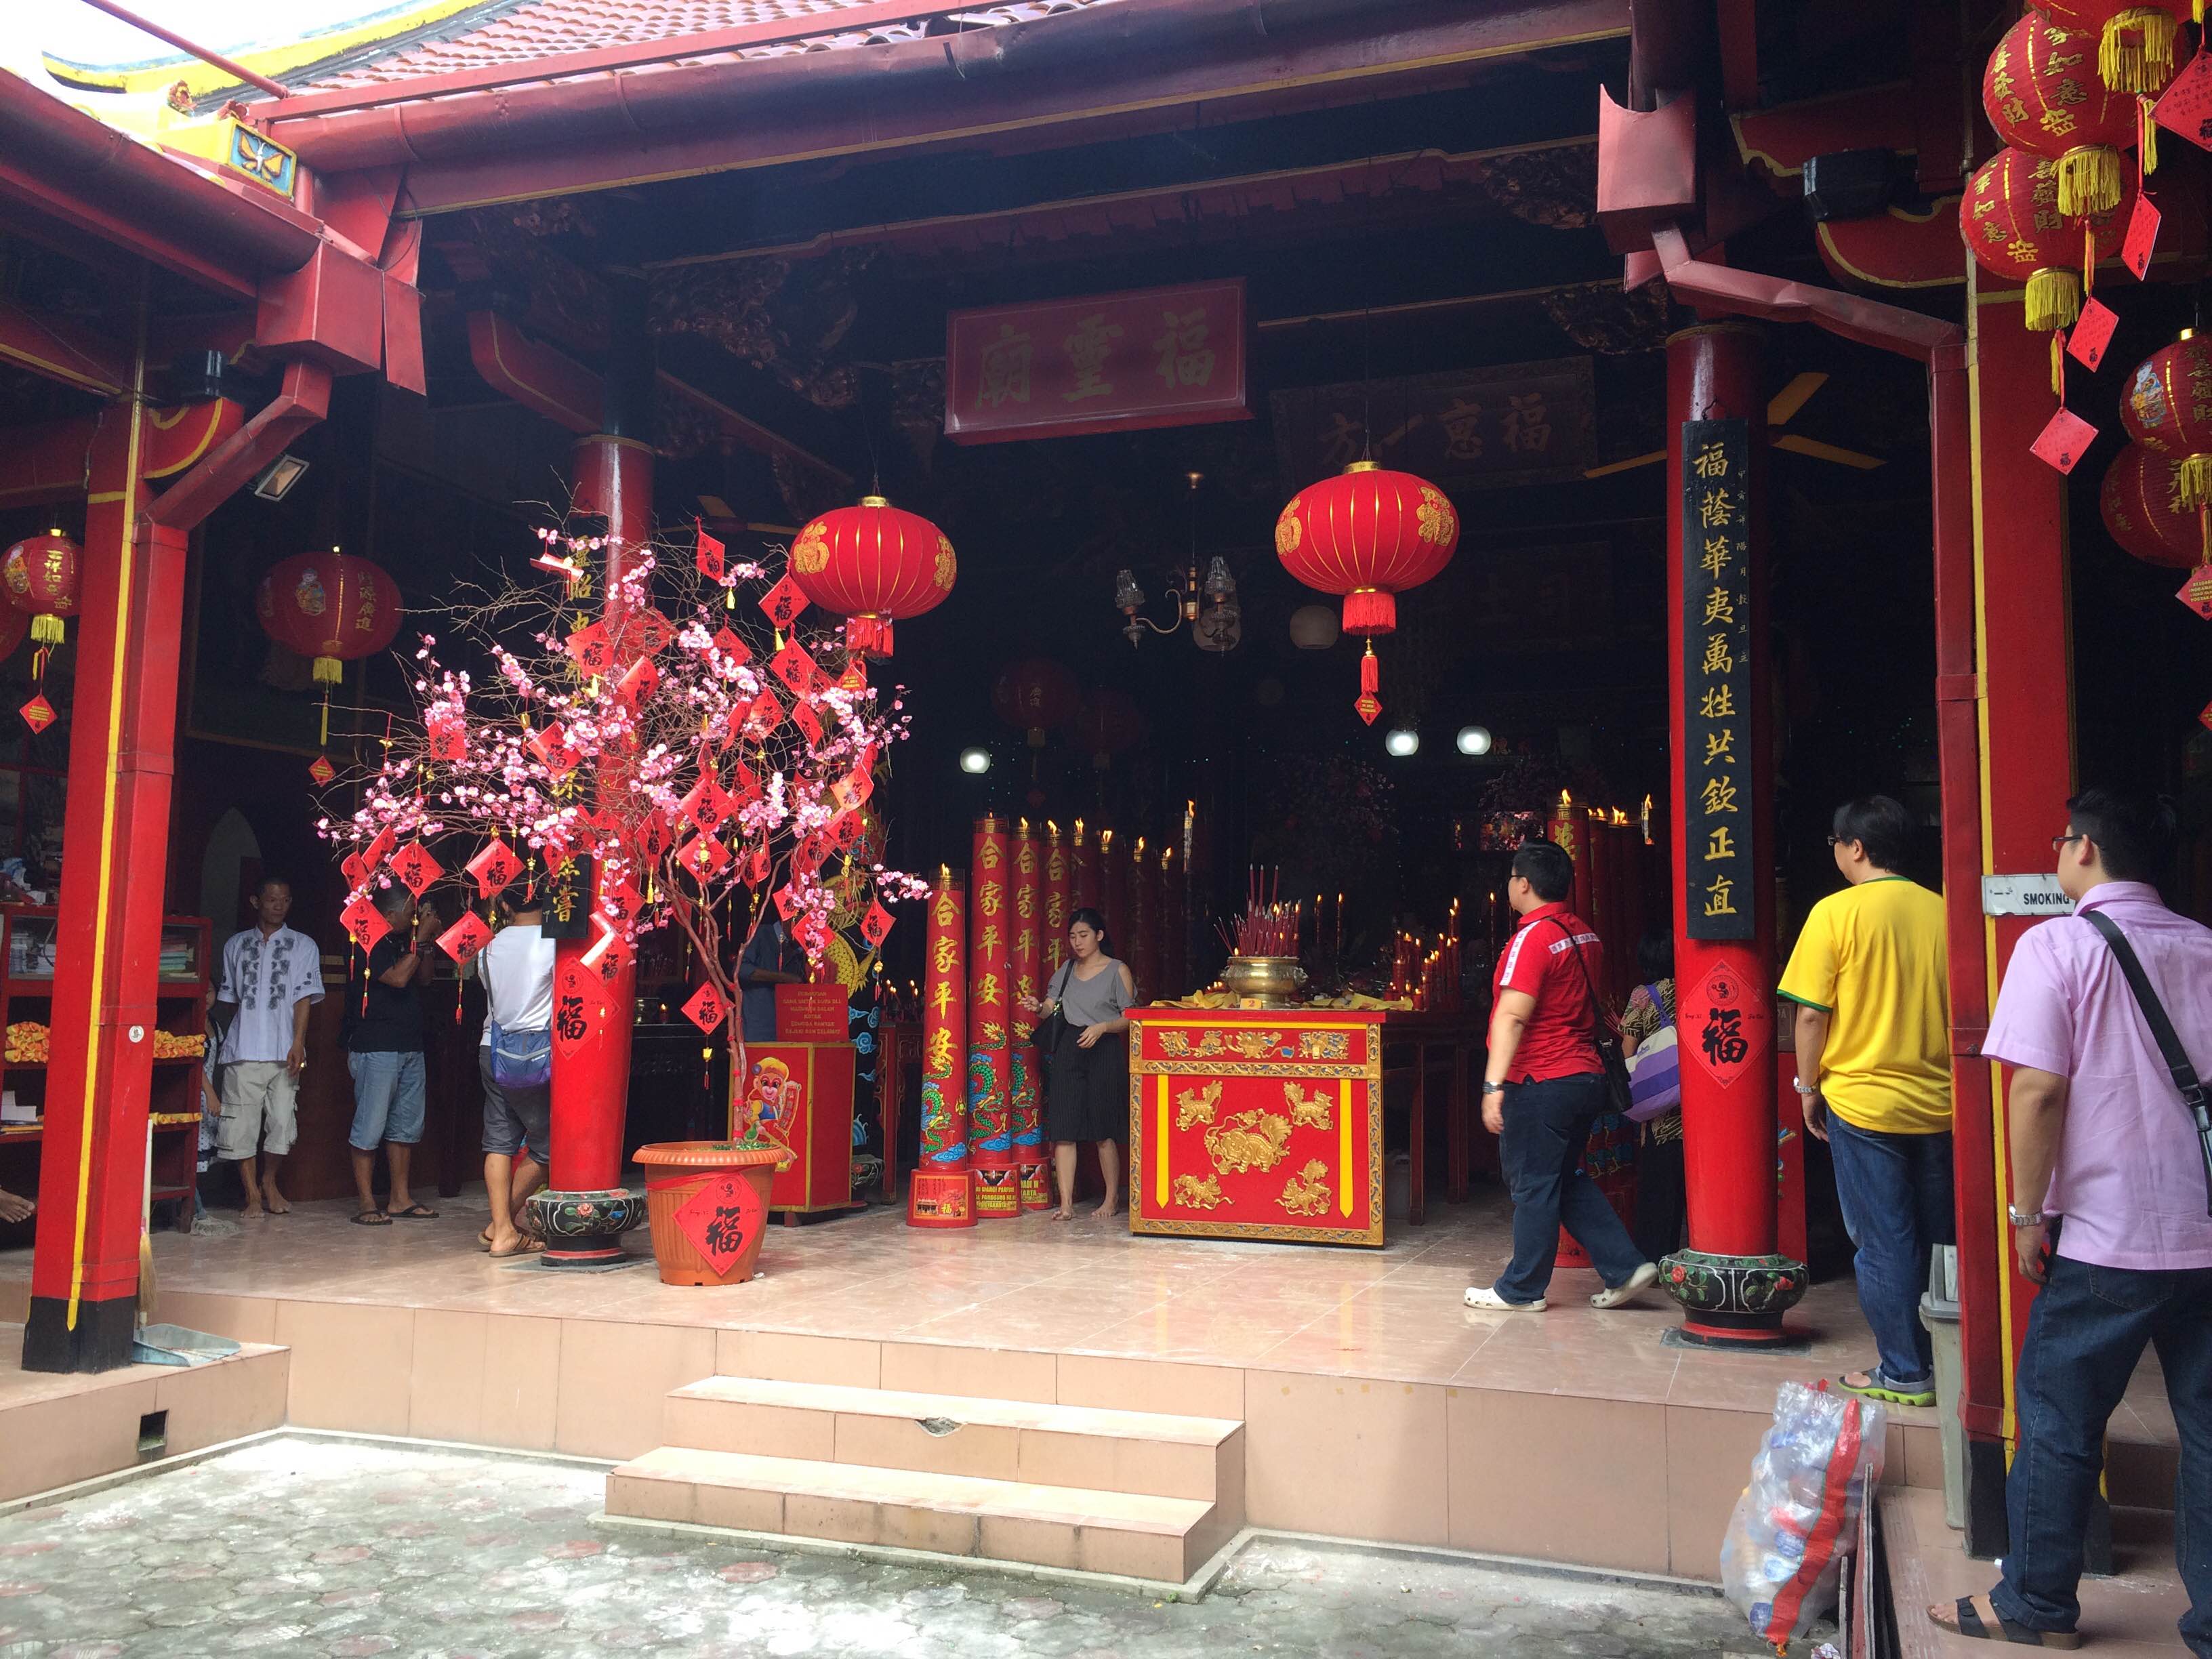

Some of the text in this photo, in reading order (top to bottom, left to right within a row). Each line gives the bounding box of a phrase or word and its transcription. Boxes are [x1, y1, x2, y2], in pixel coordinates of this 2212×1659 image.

[775, 596, 792, 621] 福
[583, 640, 604, 667] 福
[786, 659, 802, 684] 福
[697, 798, 718, 824] 福
[405, 861, 424, 888] 福
[487, 861, 507, 886] 福
[2024, 893, 2070, 905] SMOKING
[354, 918, 371, 945] 福
[973, 836, 1006, 1007] 合家平安
[457, 934, 477, 959] 福
[602, 954, 619, 980] 福
[928, 891, 962, 1063] 合家平安
[699, 1000, 718, 1025] 福
[1247, 1000, 1255, 1008] 2
[557, 995, 588, 1042] 福
[1702, 1008, 1748, 1066] 福
[941, 1203, 952, 1214] 福
[705, 1206, 743, 1256] 福
